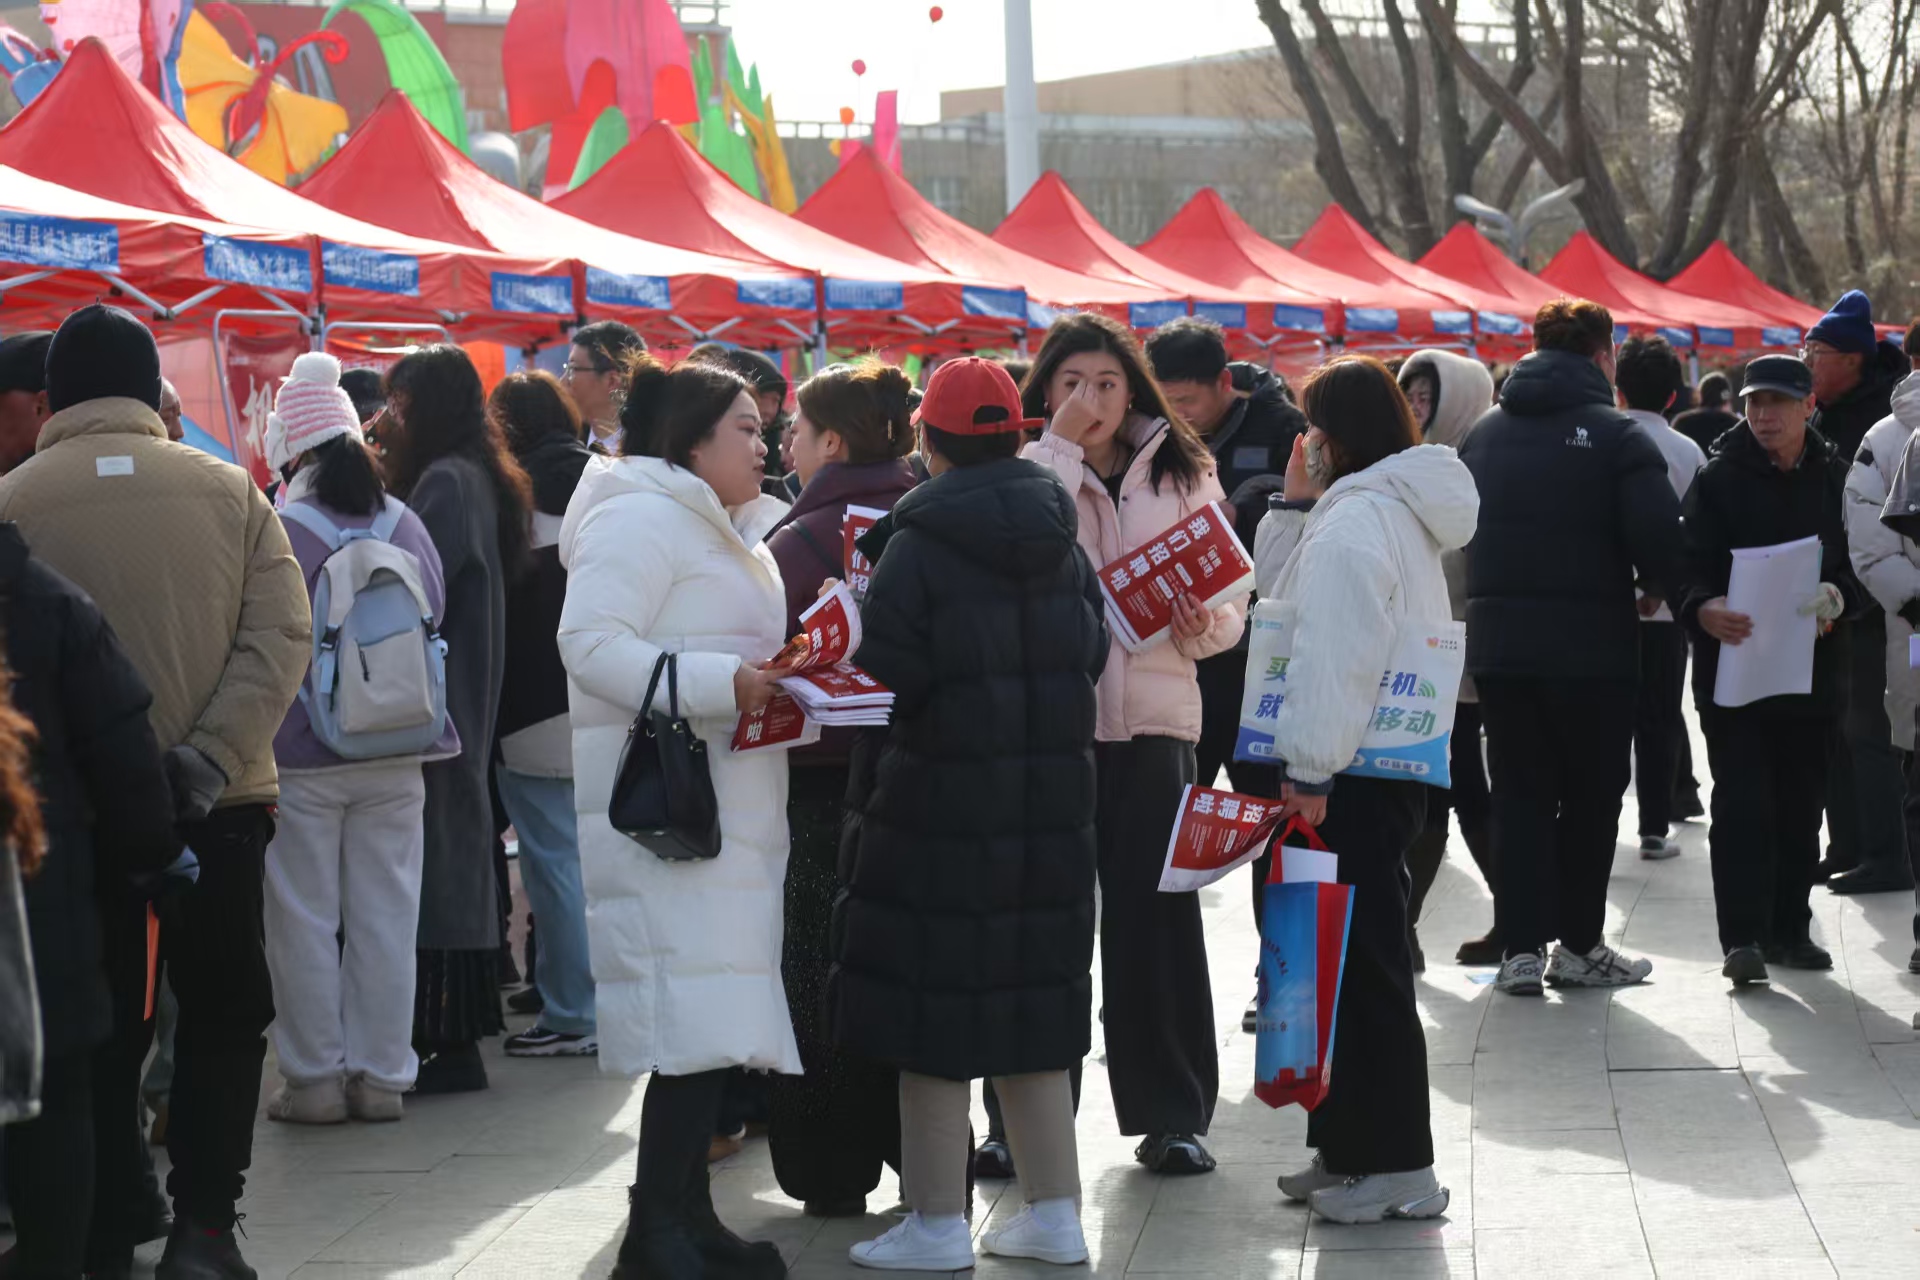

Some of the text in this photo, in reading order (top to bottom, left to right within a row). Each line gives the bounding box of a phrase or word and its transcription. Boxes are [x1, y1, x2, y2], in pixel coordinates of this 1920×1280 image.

[1565, 438, 1592, 449] CAMEL
[1110, 515, 1211, 592] 我们招聘啦
[1374, 706, 1437, 736] 移动
